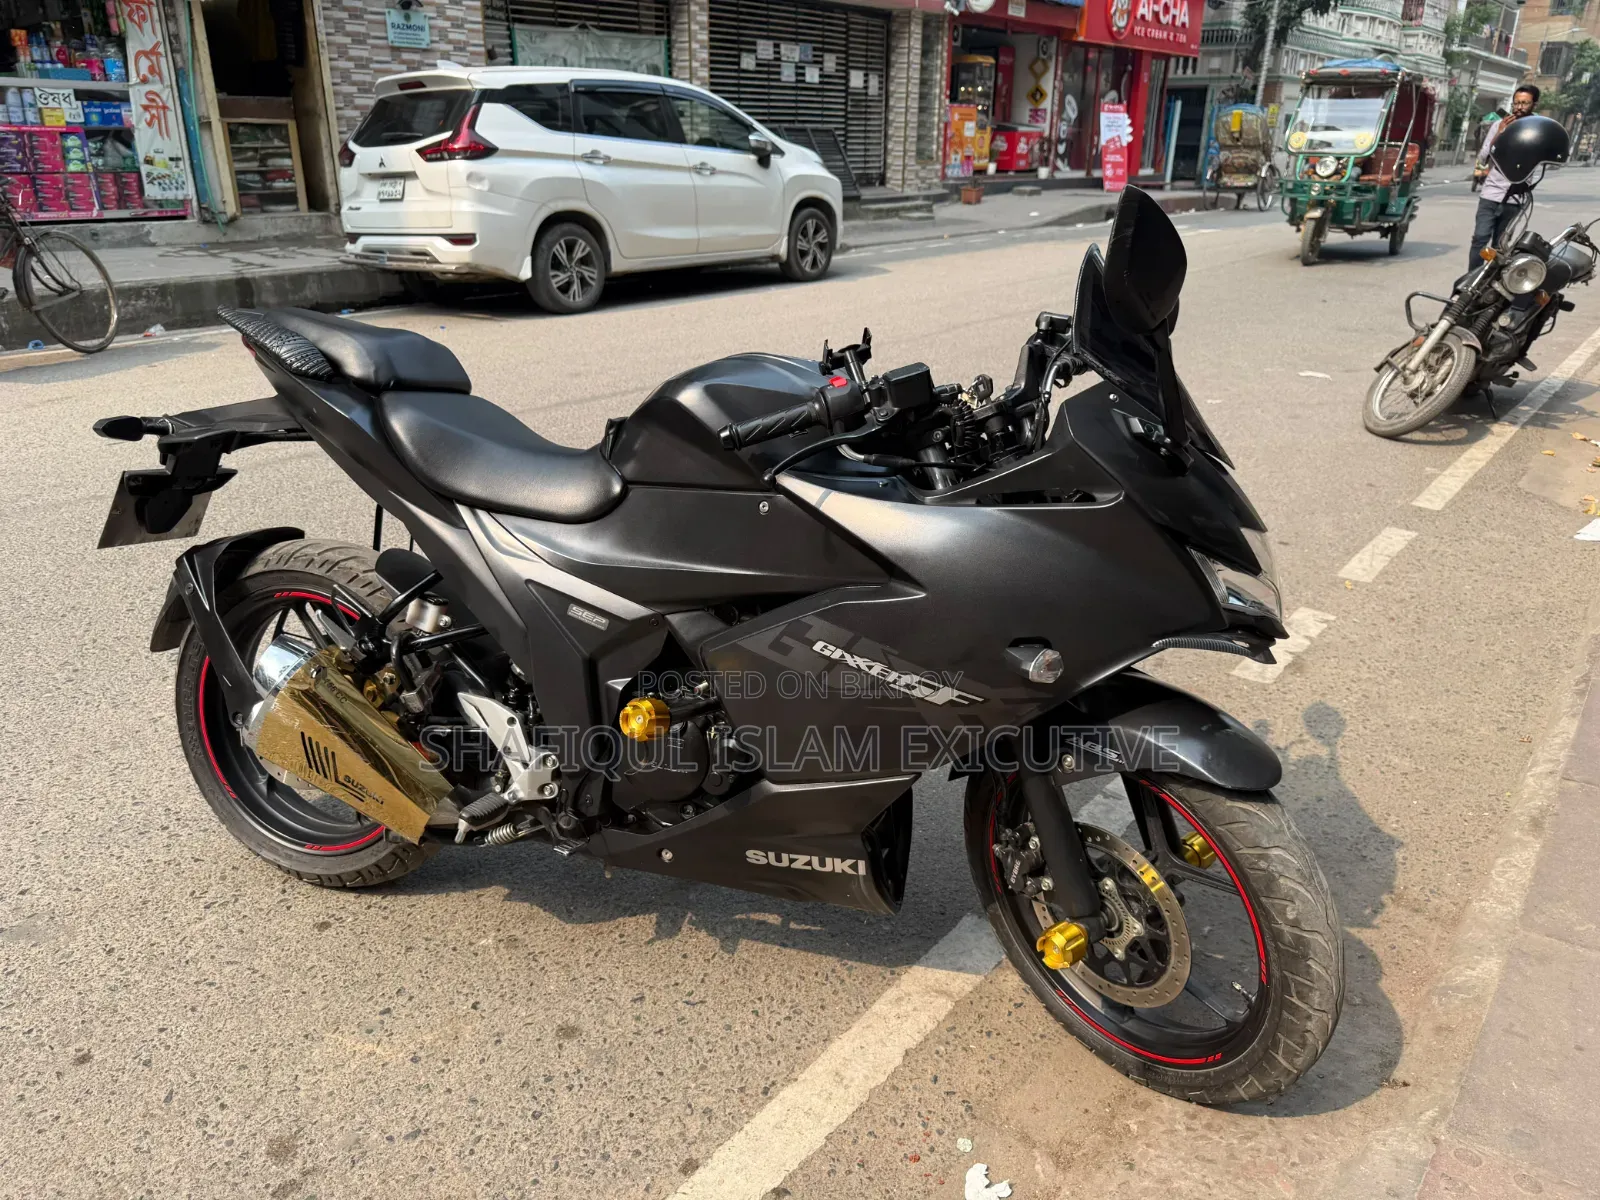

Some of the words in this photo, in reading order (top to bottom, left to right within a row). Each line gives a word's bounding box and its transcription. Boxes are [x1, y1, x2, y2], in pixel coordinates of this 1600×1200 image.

[1136, 0, 1189, 28] AI-CHA
[1134, 26, 1145, 36] ICE
[745, 849, 866, 875] SUZUKI
